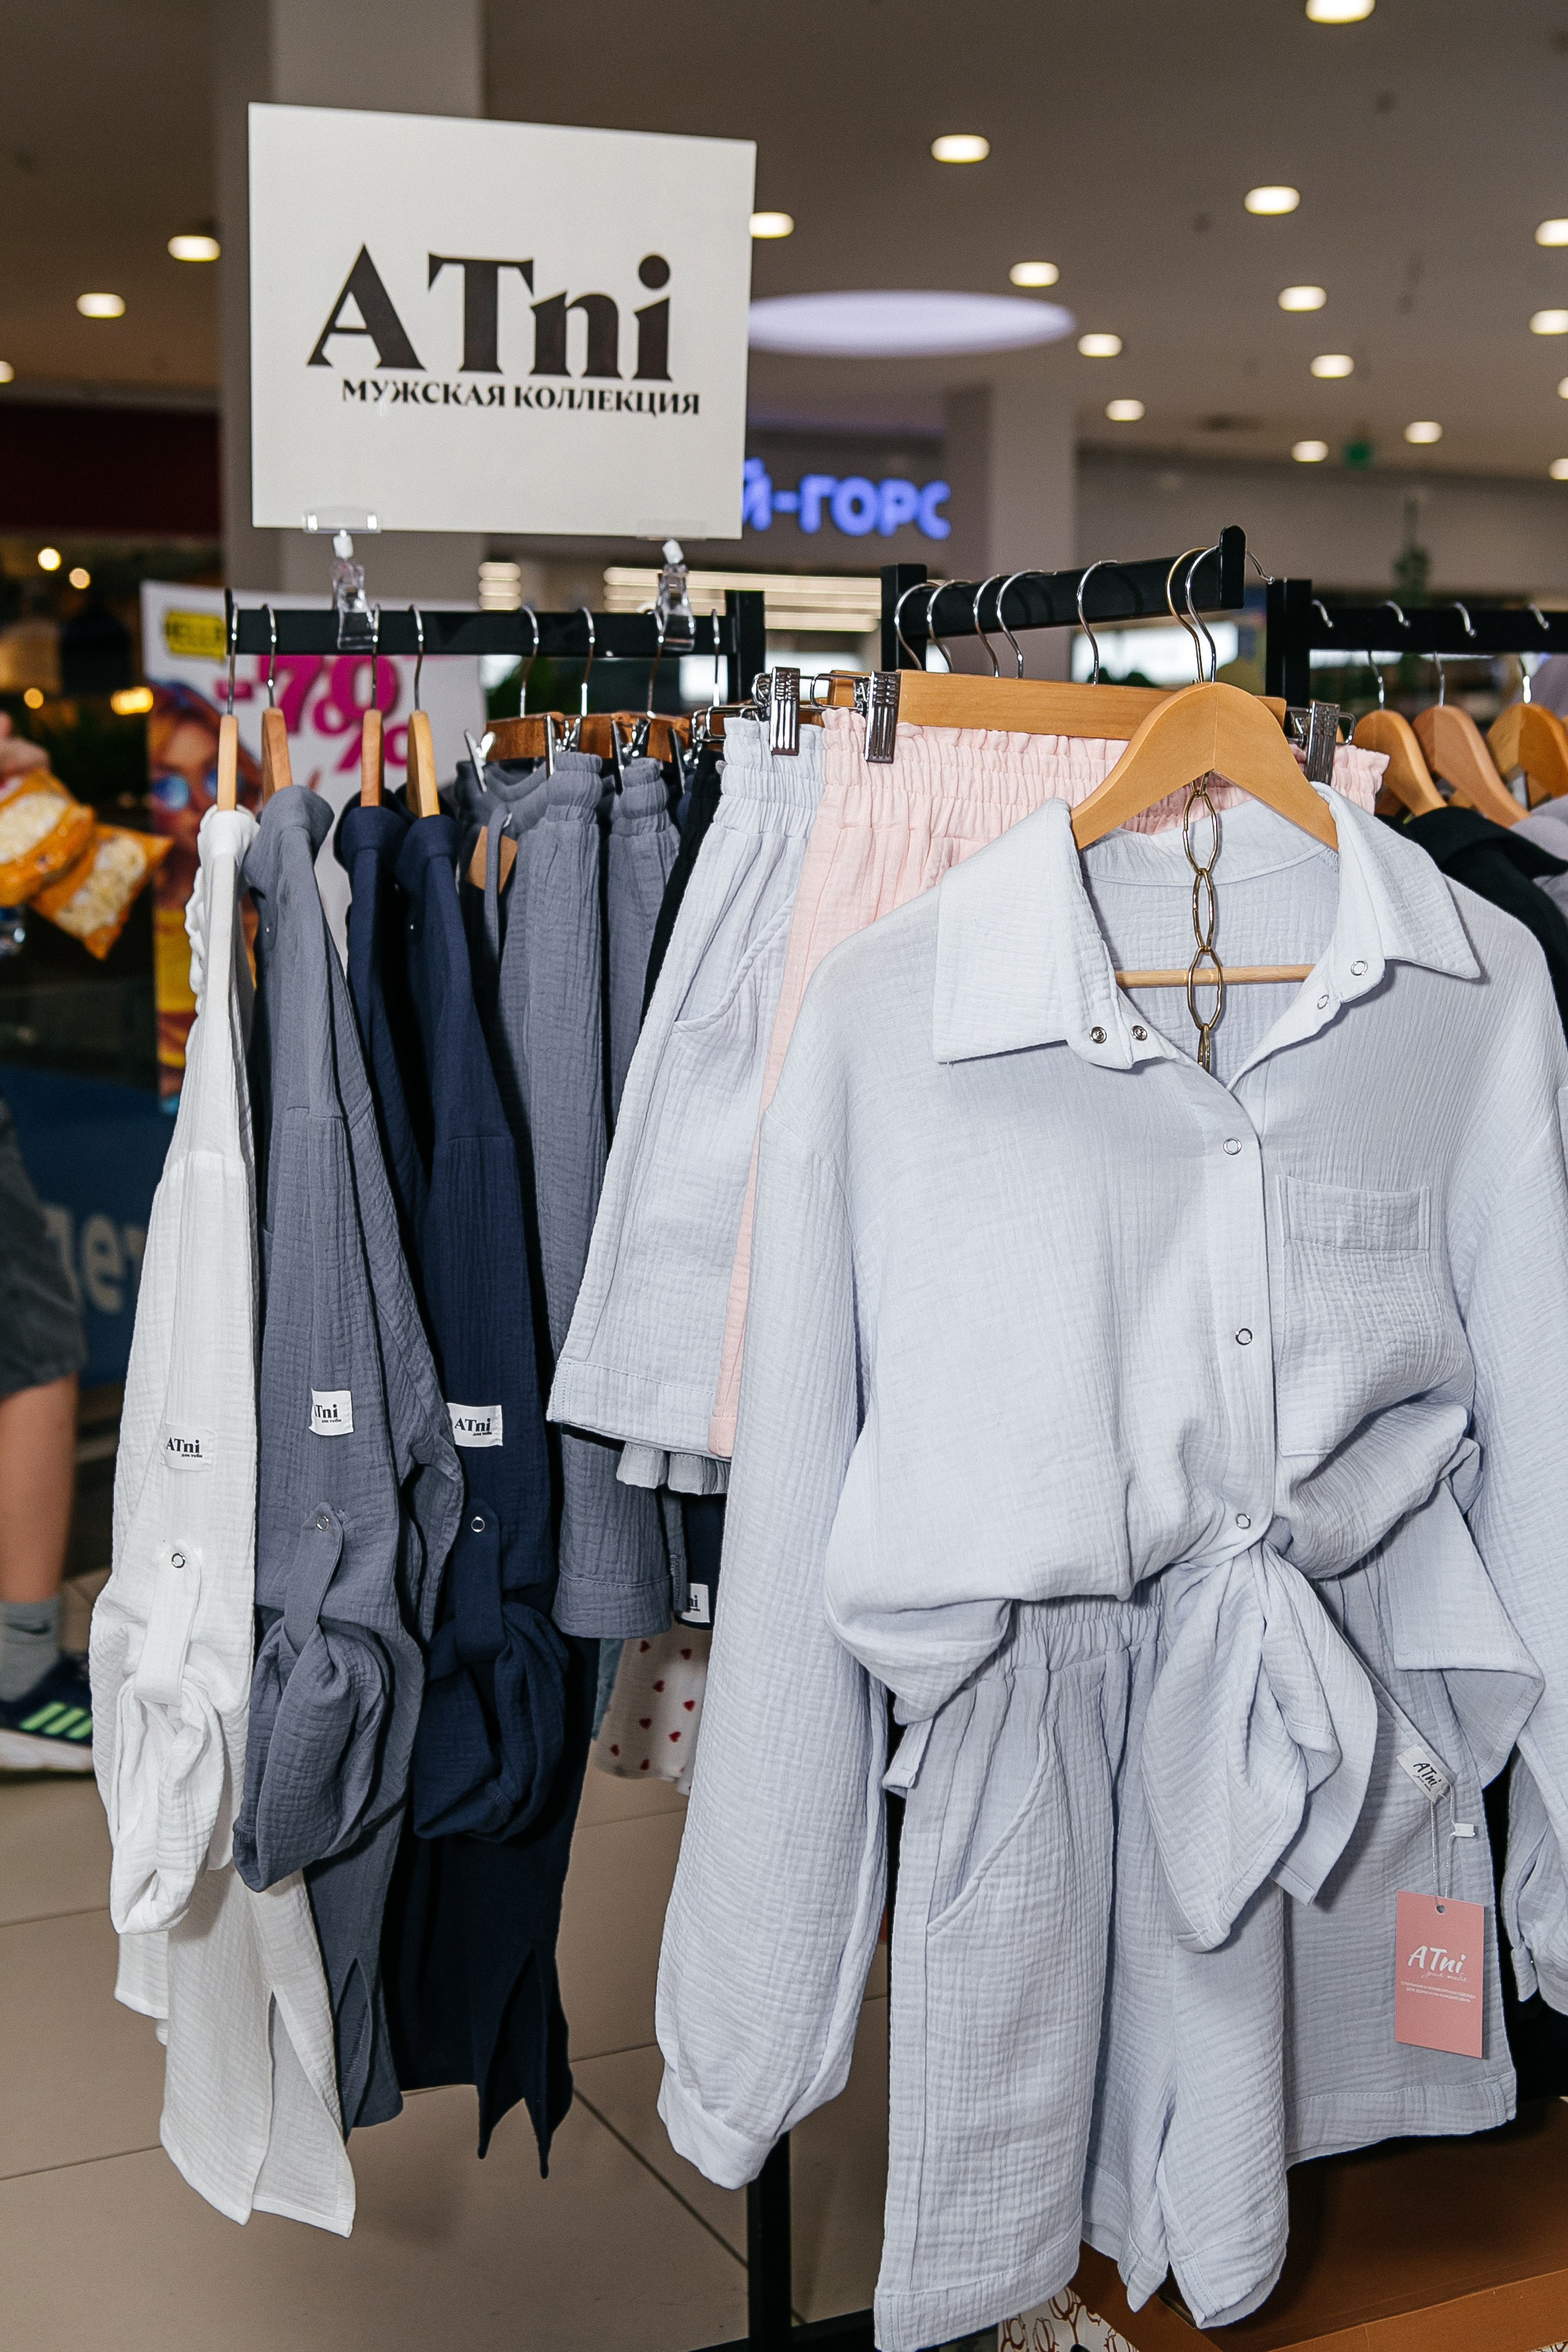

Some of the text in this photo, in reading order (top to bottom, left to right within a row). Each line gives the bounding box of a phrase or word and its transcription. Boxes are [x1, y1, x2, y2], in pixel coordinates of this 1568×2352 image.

[307, 243, 673, 382] ATni
[342, 379, 699, 417] МУЖСКАЯ КОЛЛЕКЦИЯ
[454, 1417, 491, 1432] ATni
[166, 1437, 200, 1453] ATni
[1413, 1763, 1442, 1786] ATni
[1408, 1945, 1467, 1973] ATni
